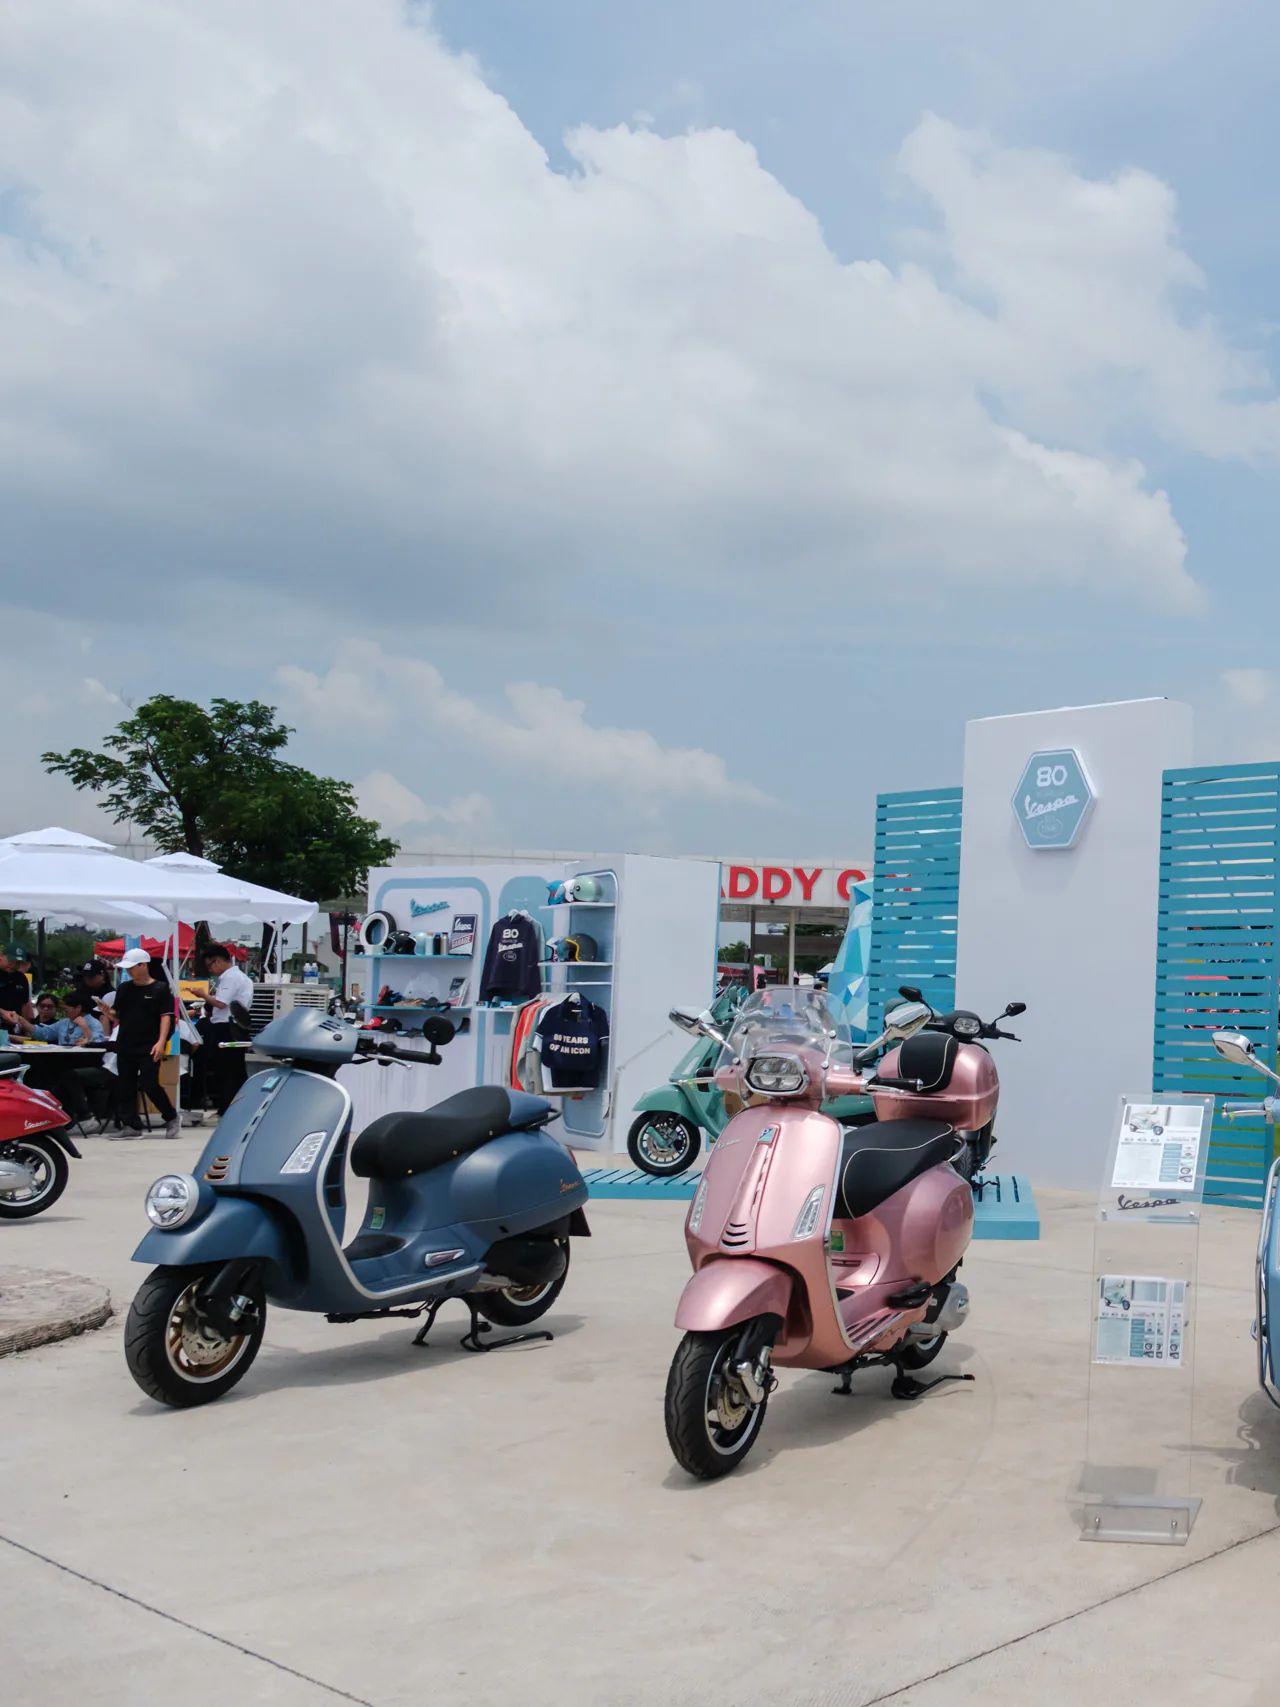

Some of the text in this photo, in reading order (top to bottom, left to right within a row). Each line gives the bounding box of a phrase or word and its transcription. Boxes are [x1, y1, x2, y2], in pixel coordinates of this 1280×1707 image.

[1036, 765, 1068, 787] 80
[1024, 794, 1079, 819] Vespa
[410, 897, 451, 918] Vespa
[502, 928, 519, 939] 80
[498, 942, 523, 952] Vespa
[549, 1043, 560, 1051] OF
[563, 1036, 589, 1044] YEARS
[1116, 1194, 1182, 1211] Vespa
